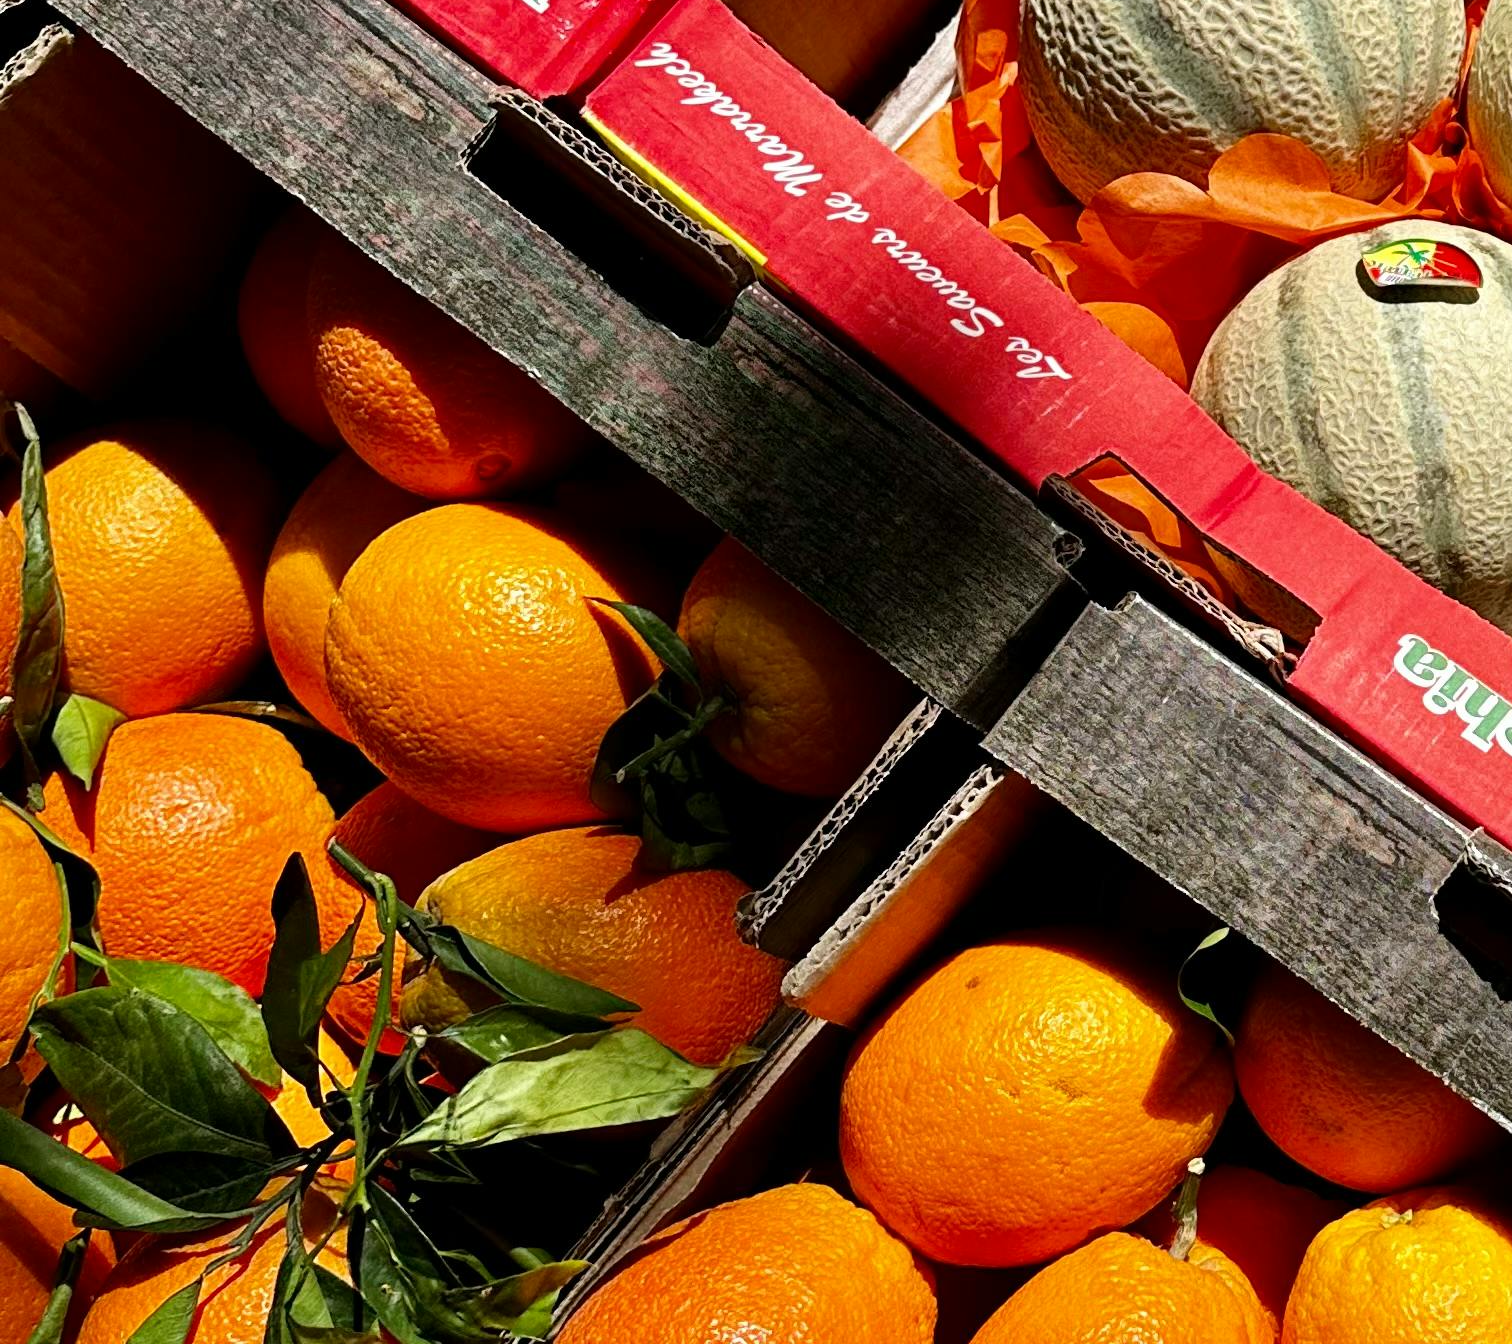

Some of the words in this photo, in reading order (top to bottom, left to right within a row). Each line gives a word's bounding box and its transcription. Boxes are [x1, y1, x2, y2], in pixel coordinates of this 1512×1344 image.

[634, 41, 823, 197] Marrakech
[825, 191, 871, 224] de
[872, 227, 1004, 339] Saveurs
[1007, 337, 1073, 380] Les
